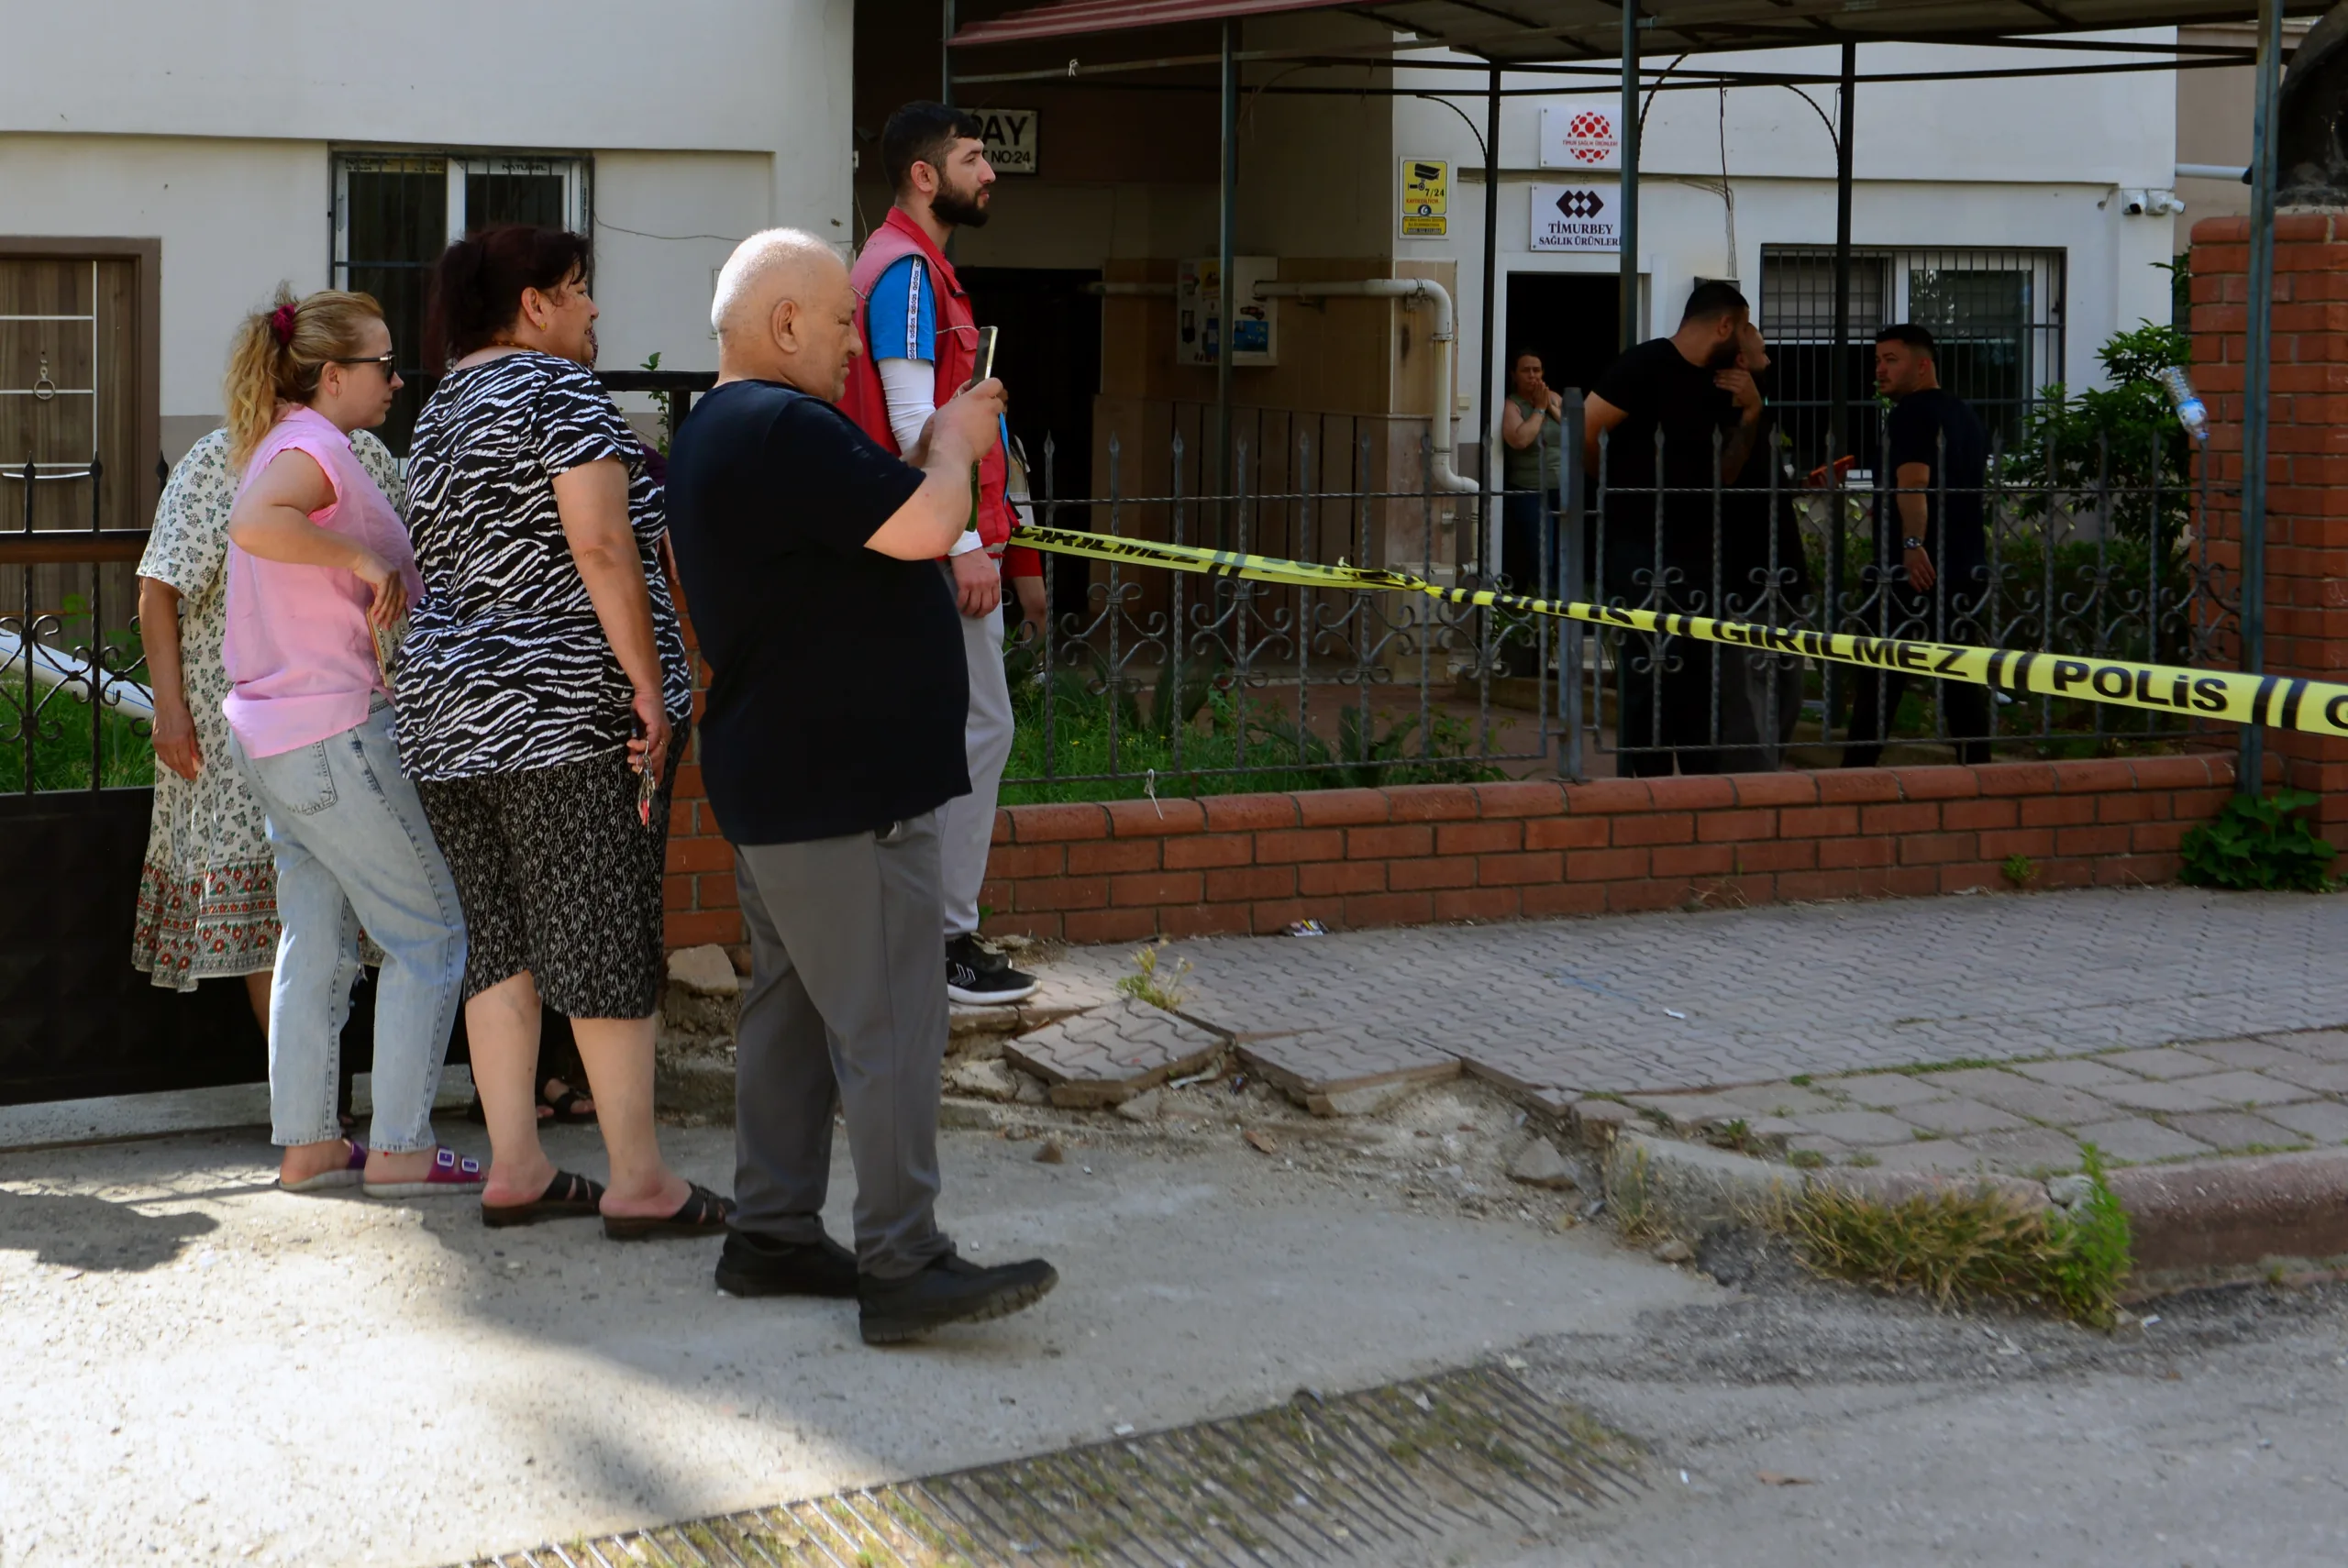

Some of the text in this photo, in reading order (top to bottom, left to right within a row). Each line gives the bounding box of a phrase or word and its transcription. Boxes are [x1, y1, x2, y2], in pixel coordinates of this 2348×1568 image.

[971, 114, 1029, 146] AY
[1424, 188, 1445, 198] 7/24
[1548, 220, 1613, 235] TİMURBEY
[1538, 235, 1573, 246] SAĞLIK
